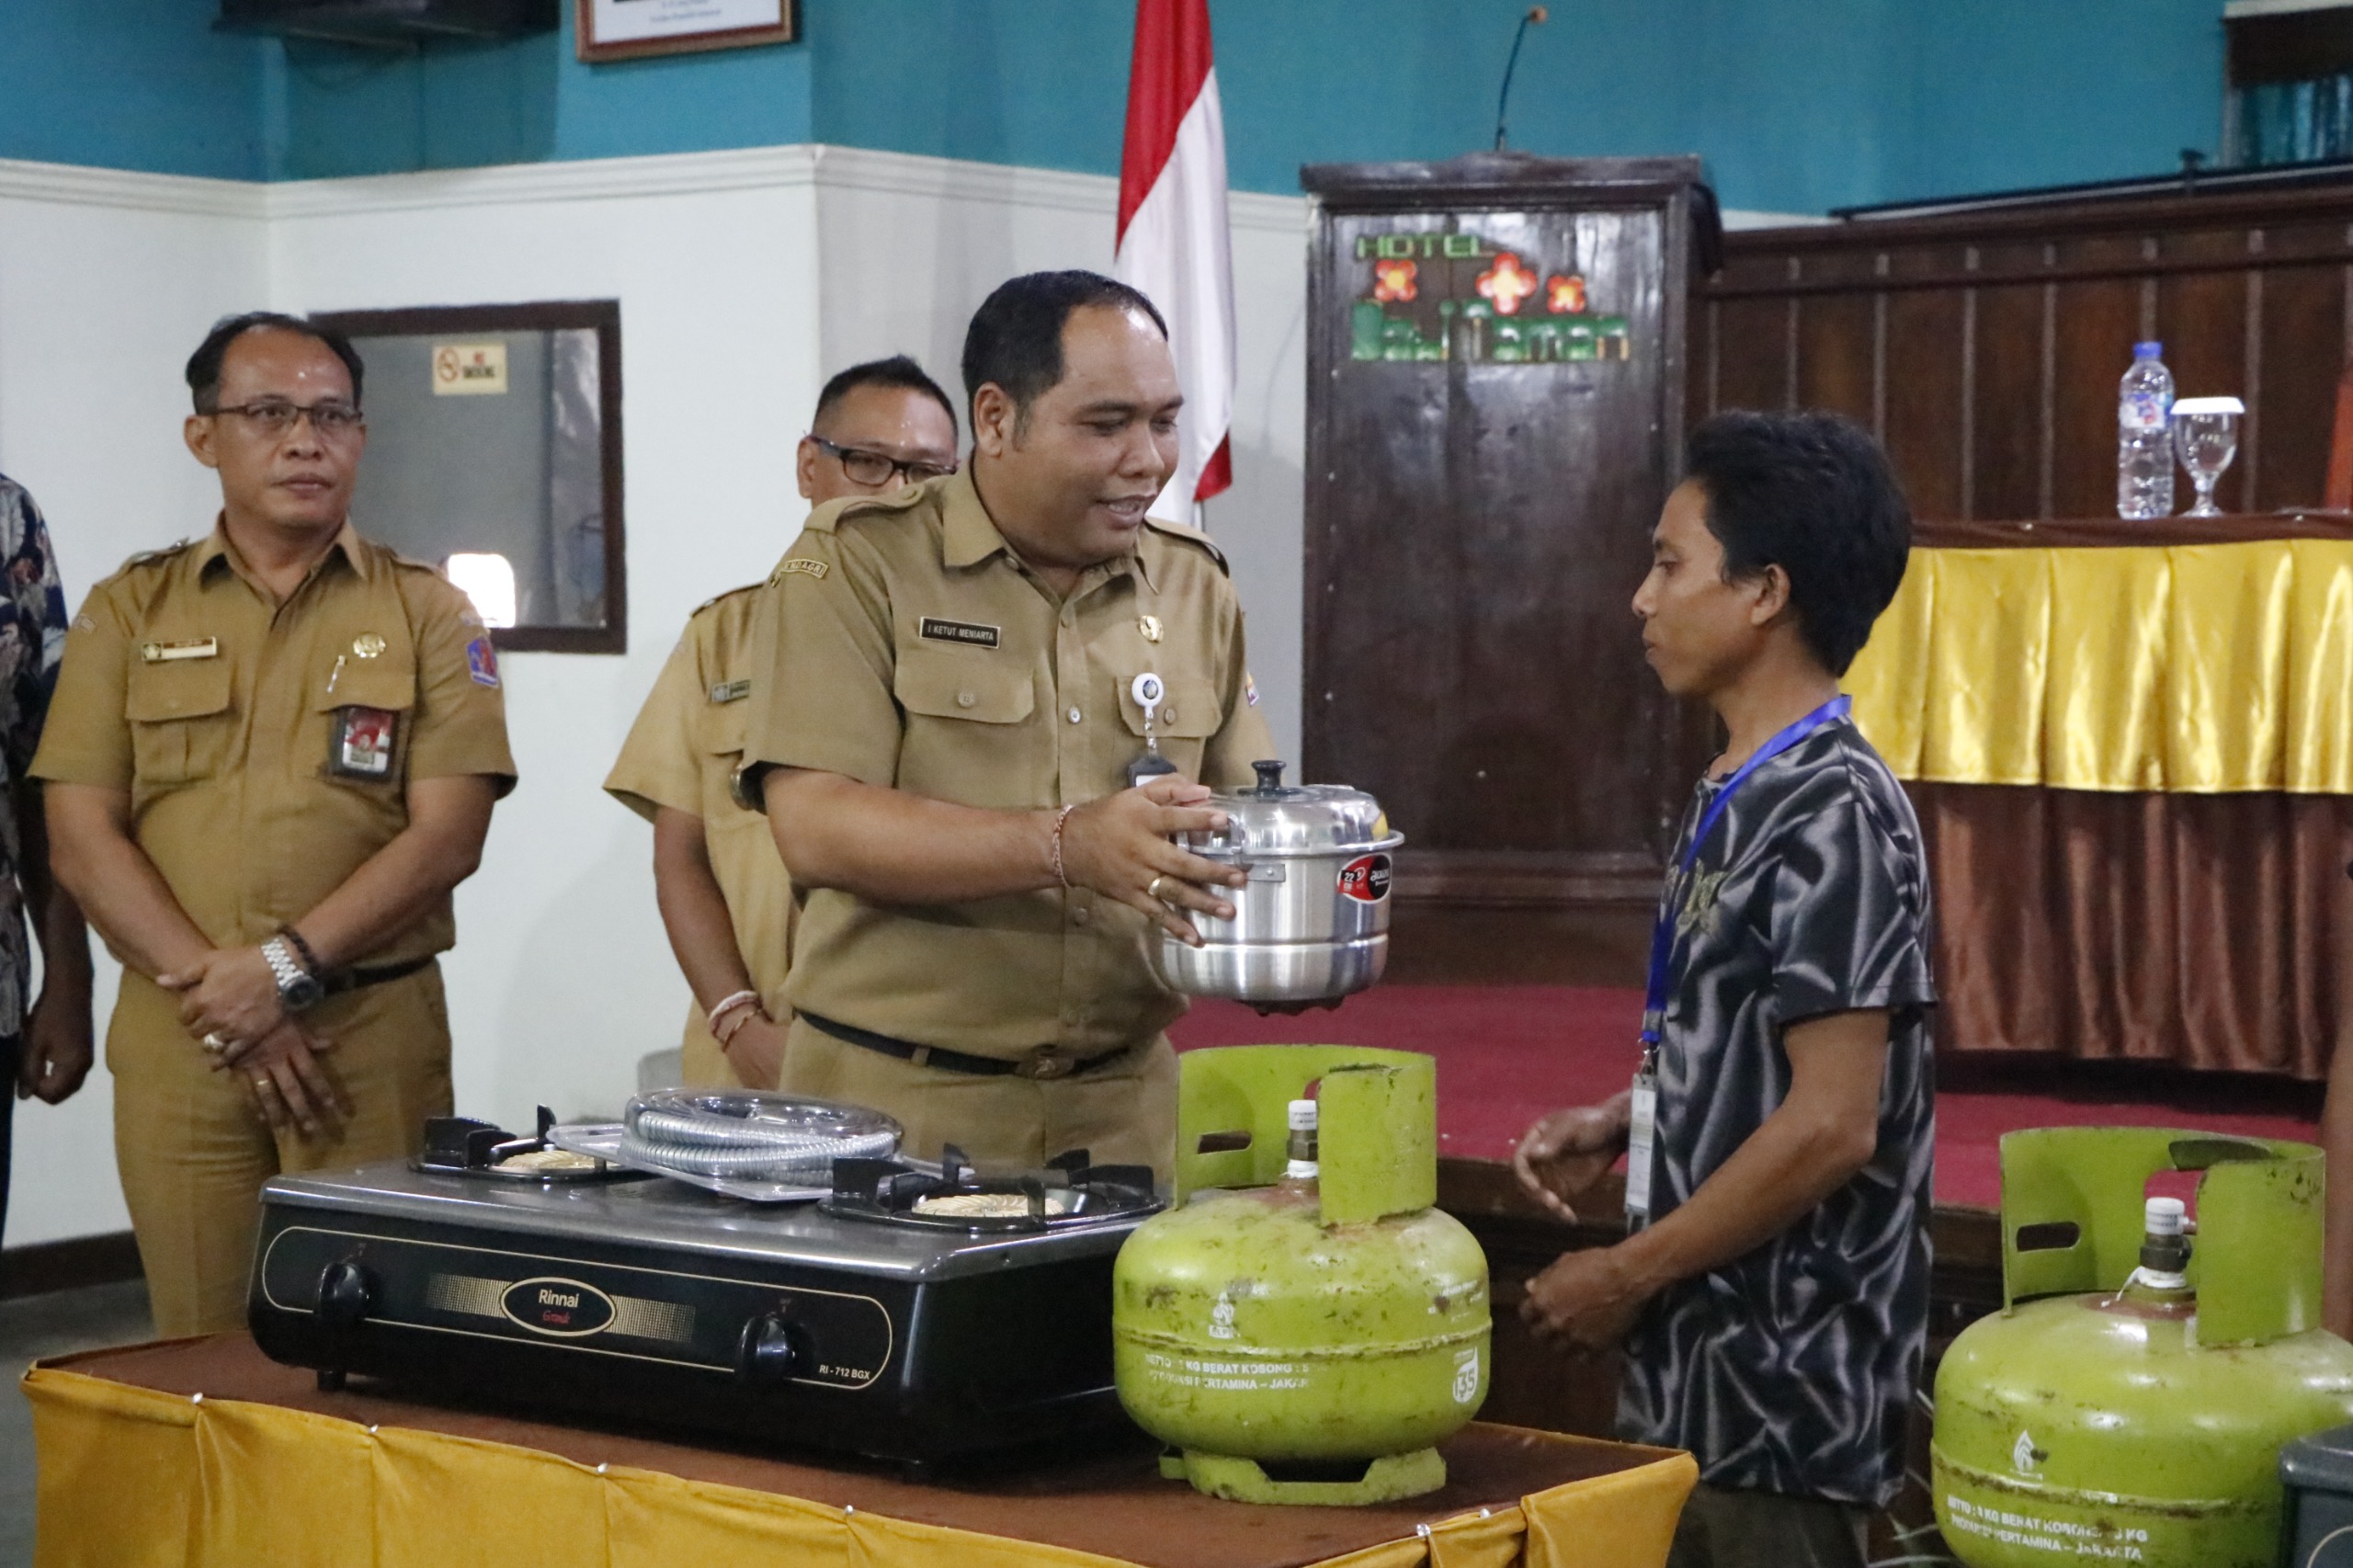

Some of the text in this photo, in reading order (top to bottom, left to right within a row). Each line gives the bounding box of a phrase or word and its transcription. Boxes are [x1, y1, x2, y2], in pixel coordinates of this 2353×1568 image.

[1356, 234, 1495, 258] HOTEL
[934, 625, 957, 636] KETUT
[959, 628, 994, 641] MENIARTA
[1345, 872, 1355, 882] 22
[539, 1289, 580, 1308] Rinnai
[819, 1364, 829, 1375] RI
[835, 1366, 850, 1378] 712
[851, 1369, 870, 1381] BGX
[1186, 1360, 1200, 1372] KG
[1202, 1362, 1239, 1374] BERAT
[1241, 1363, 1292, 1375] KOSONG
[1984, 1508, 1999, 1522] KG
[2001, 1512, 2041, 1530] BERAT
[2125, 1528, 2148, 1542] KG
[2075, 1541, 2143, 1561] JAKATA
